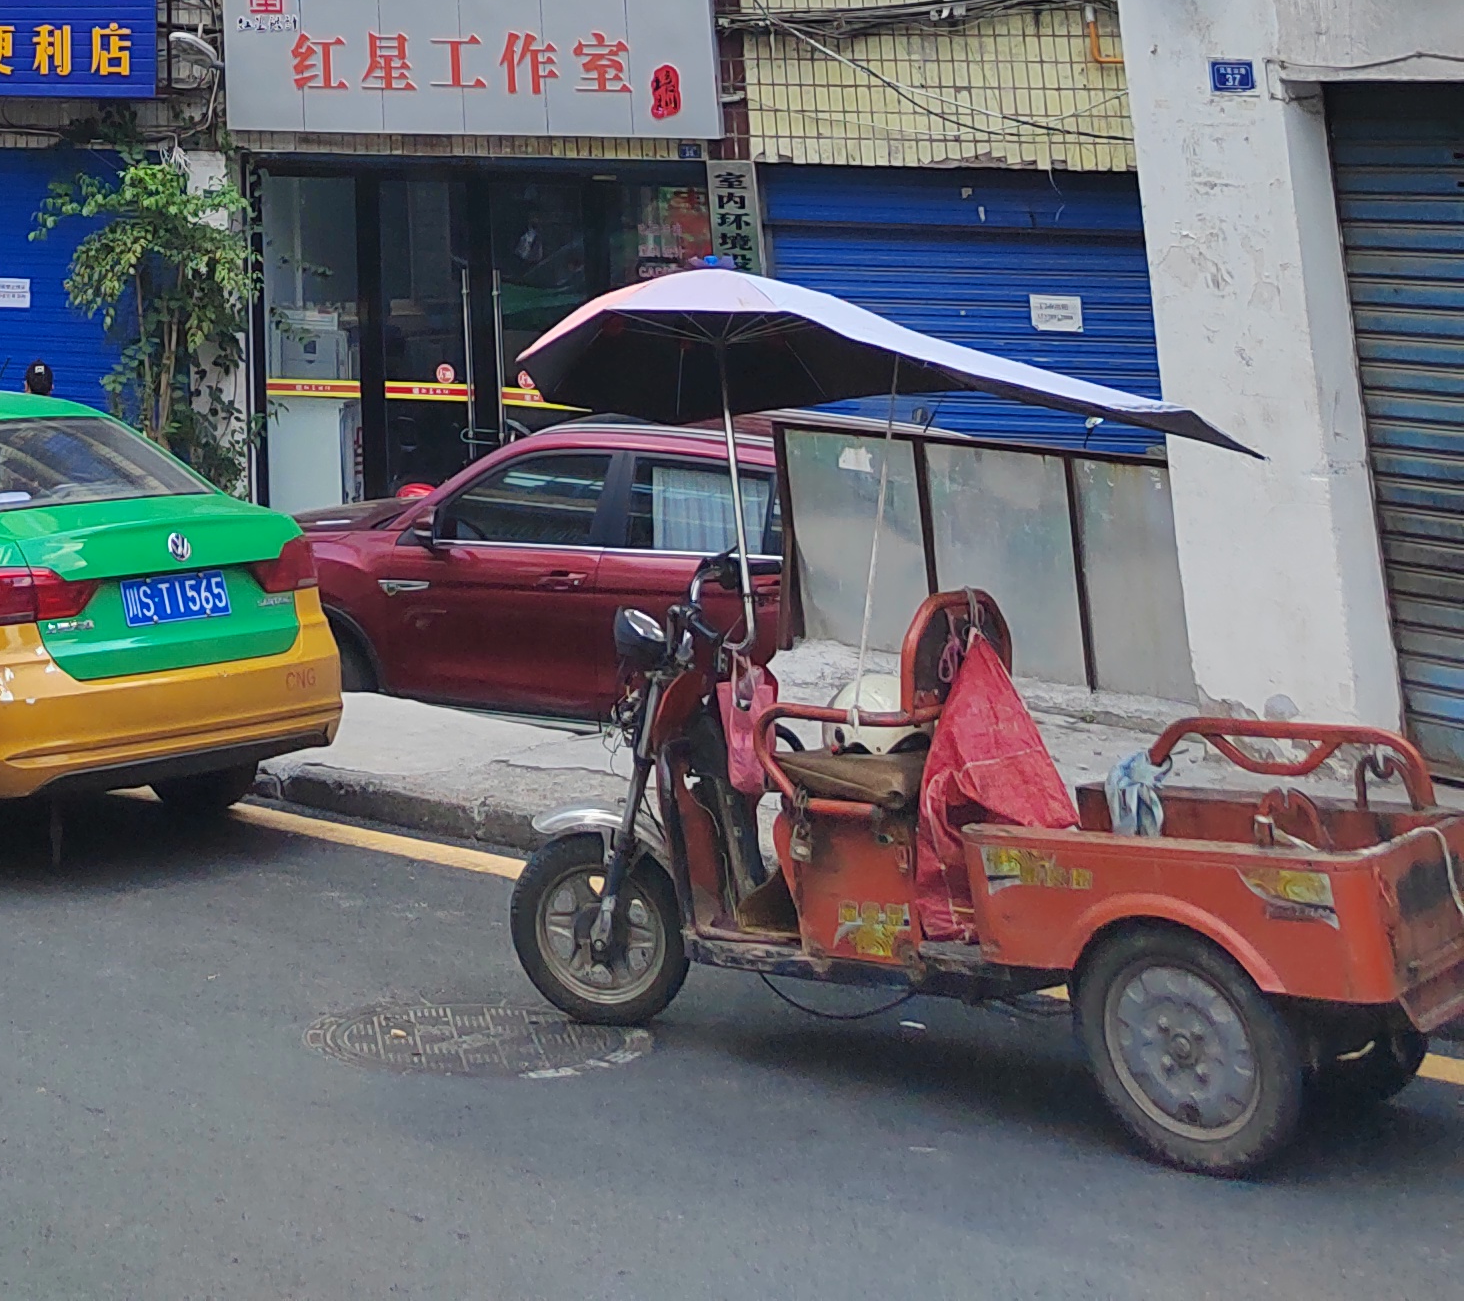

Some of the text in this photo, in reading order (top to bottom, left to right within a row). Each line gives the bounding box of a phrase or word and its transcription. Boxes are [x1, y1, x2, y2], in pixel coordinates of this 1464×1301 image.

[290, 31, 634, 95] 红星工作室
[1226, 74, 1241, 86] 37
